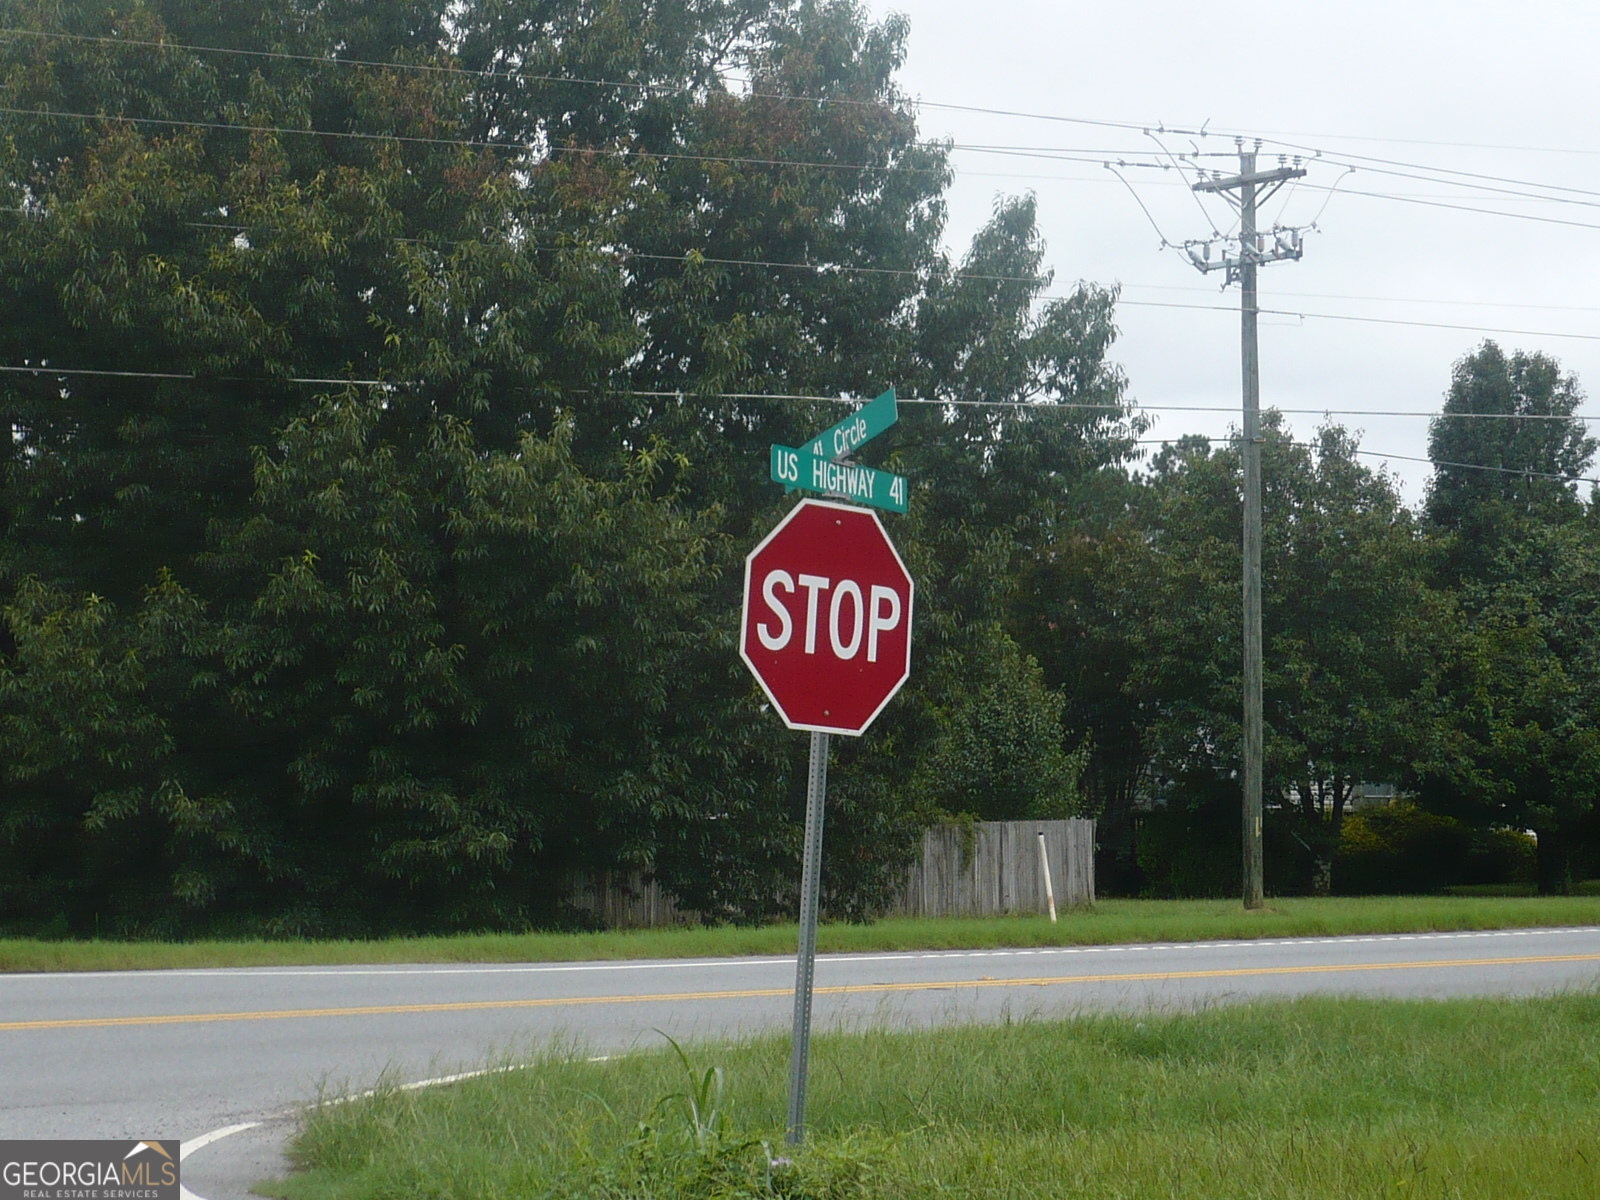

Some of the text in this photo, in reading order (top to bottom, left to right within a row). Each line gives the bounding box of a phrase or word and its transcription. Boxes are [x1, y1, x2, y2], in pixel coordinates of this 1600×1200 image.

[834, 418, 867, 455] Circle
[777, 450, 903, 505] US HIGHWAY 41
[757, 569, 901, 663] STOP
